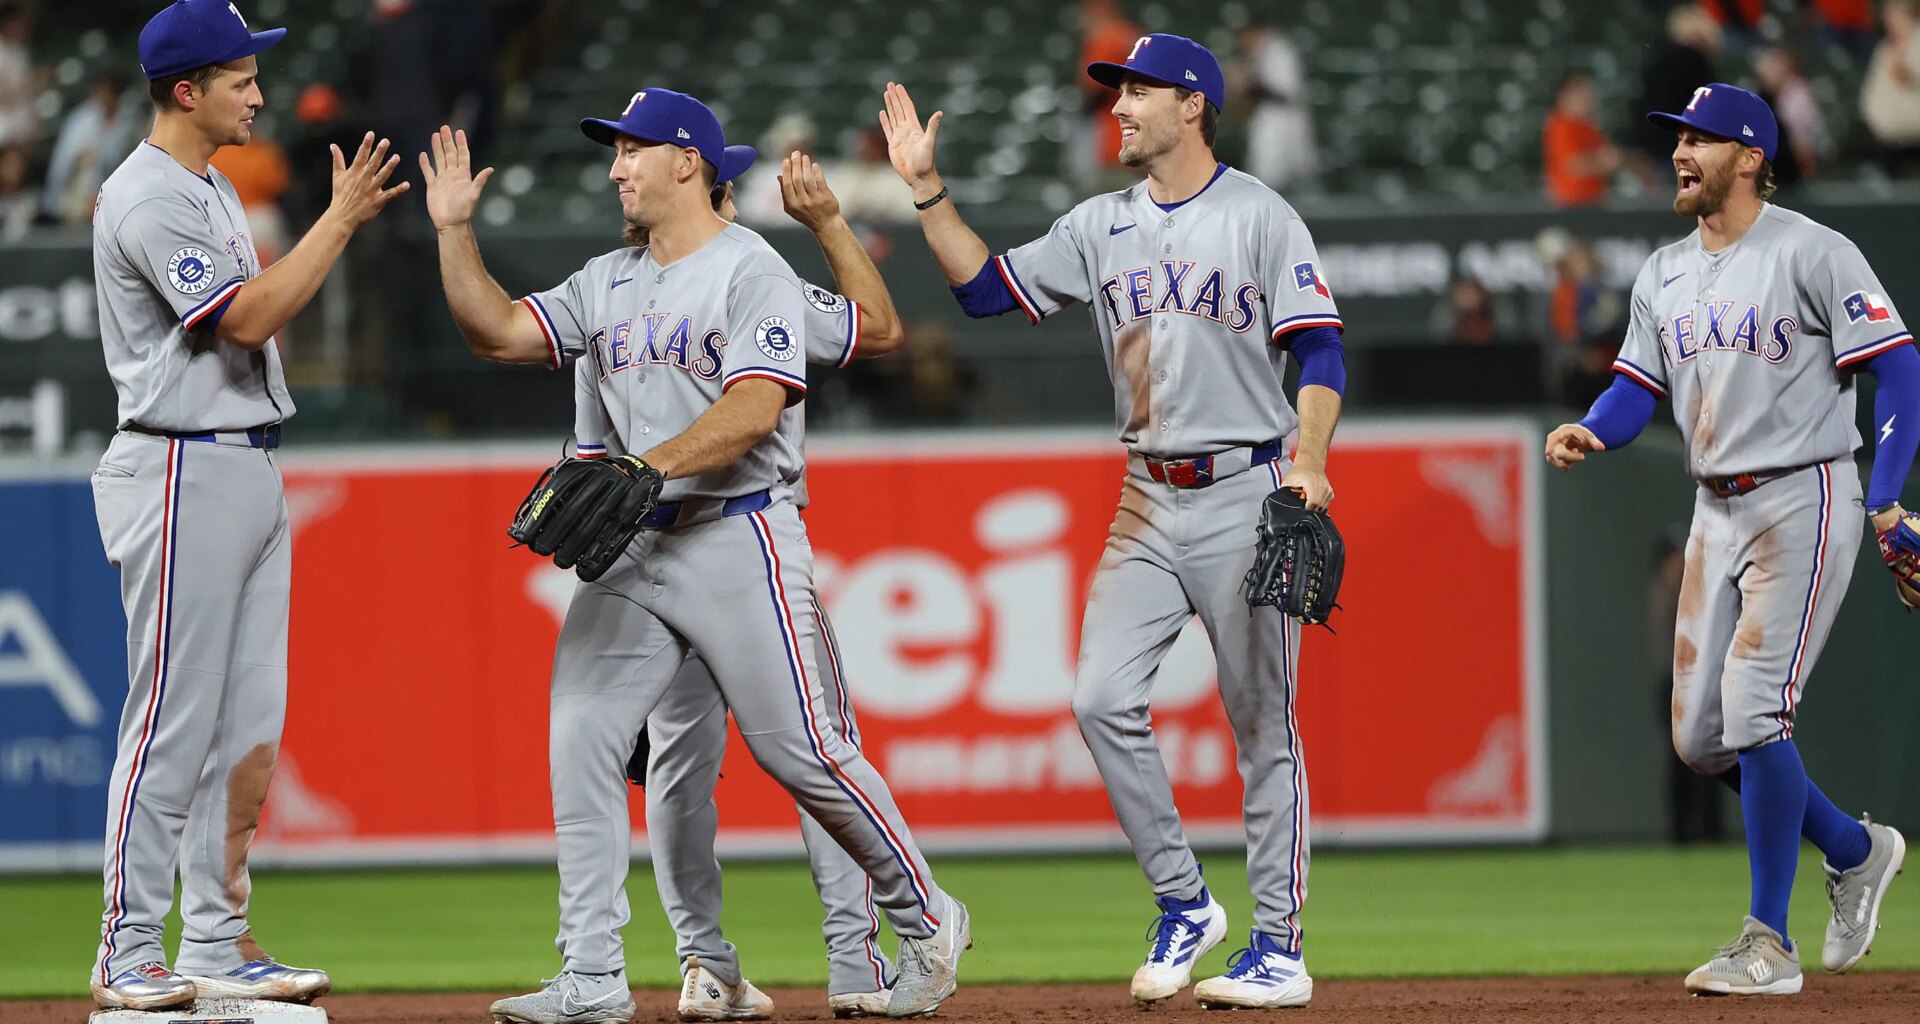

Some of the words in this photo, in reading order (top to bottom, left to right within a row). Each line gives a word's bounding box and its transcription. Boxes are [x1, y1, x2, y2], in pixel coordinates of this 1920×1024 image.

[1127, 36, 1152, 62] T
[622, 92, 646, 117] T
[1687, 87, 1712, 112] T
[169, 249, 206, 272] ENERGY
[174, 263, 213, 292] TRANSFER
[1101, 260, 1260, 333] TEXAS
[760, 318, 795, 337] ENERGY
[590, 312, 728, 382] TEXAS
[758, 338, 797, 360] TRANSFER
[531, 488, 555, 521] A2000
[886, 722, 1229, 791] markts
